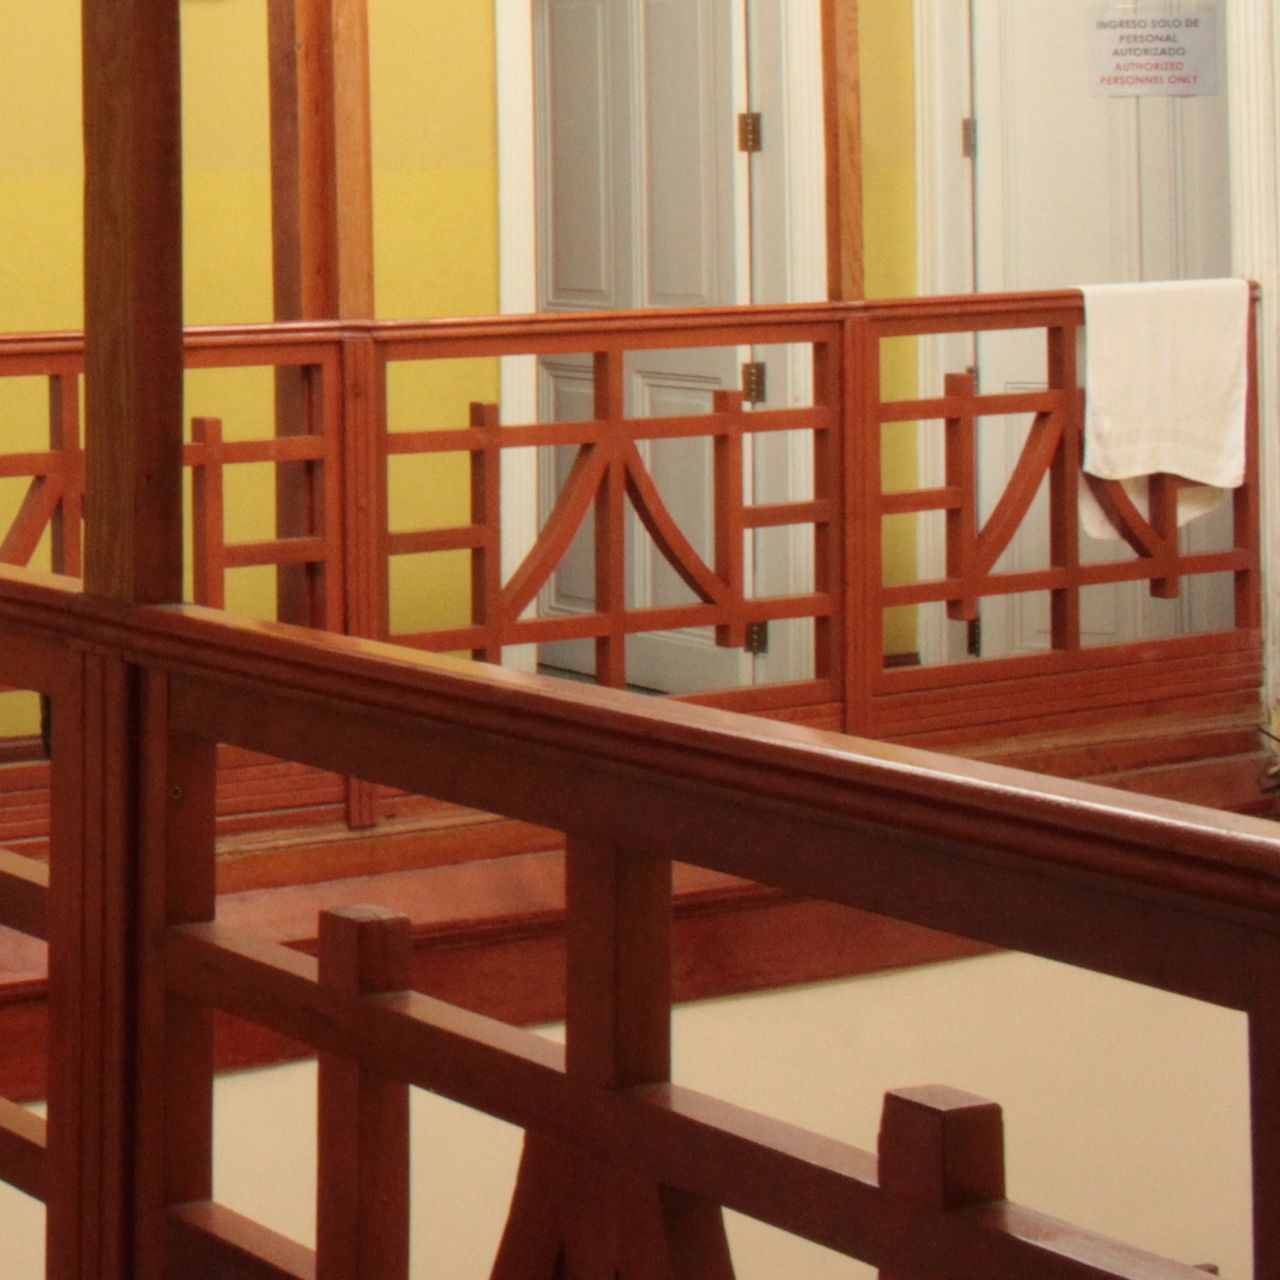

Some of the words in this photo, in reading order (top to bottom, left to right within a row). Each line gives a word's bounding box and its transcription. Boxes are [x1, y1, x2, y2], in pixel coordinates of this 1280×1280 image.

[1096, 20, 1147, 29] INGRESO
[1152, 19, 1182, 28] SOLO
[1185, 19, 1199, 28] DE
[1119, 34, 1177, 43] PERSONAL
[1112, 47, 1186, 57] AUTORIZADO
[1115, 62, 1184, 72] AUTHORIZED
[1100, 75, 1164, 85] PERSONNEL
[1168, 74, 1198, 84] ONLY
